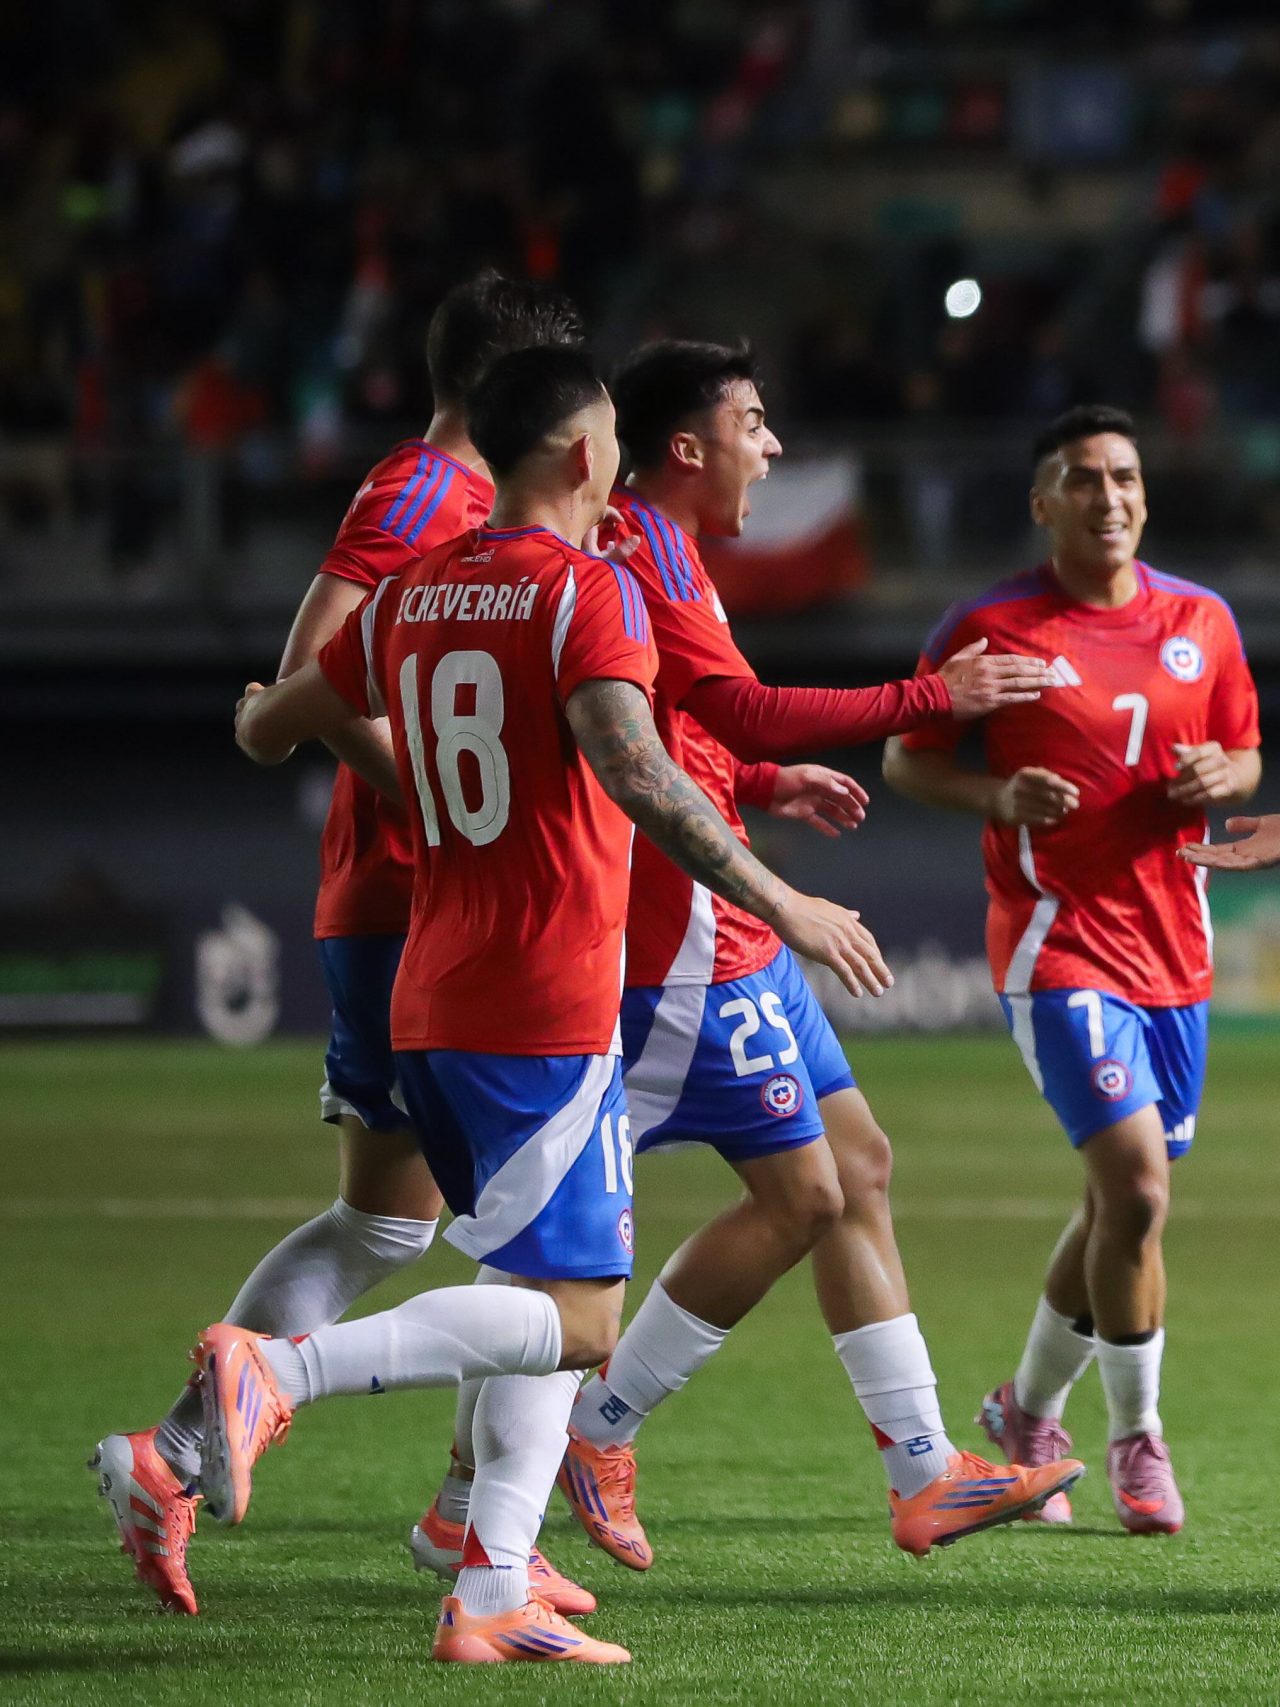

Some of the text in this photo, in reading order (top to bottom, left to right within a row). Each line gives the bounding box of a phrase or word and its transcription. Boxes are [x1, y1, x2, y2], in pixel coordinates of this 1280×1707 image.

[399, 650, 510, 848] 18
[1112, 692, 1149, 767] 7
[718, 992, 800, 1076] 25
[1067, 987, 1107, 1059] 7
[601, 1113, 633, 1196] 18
[592, 1521, 647, 1561] F50
